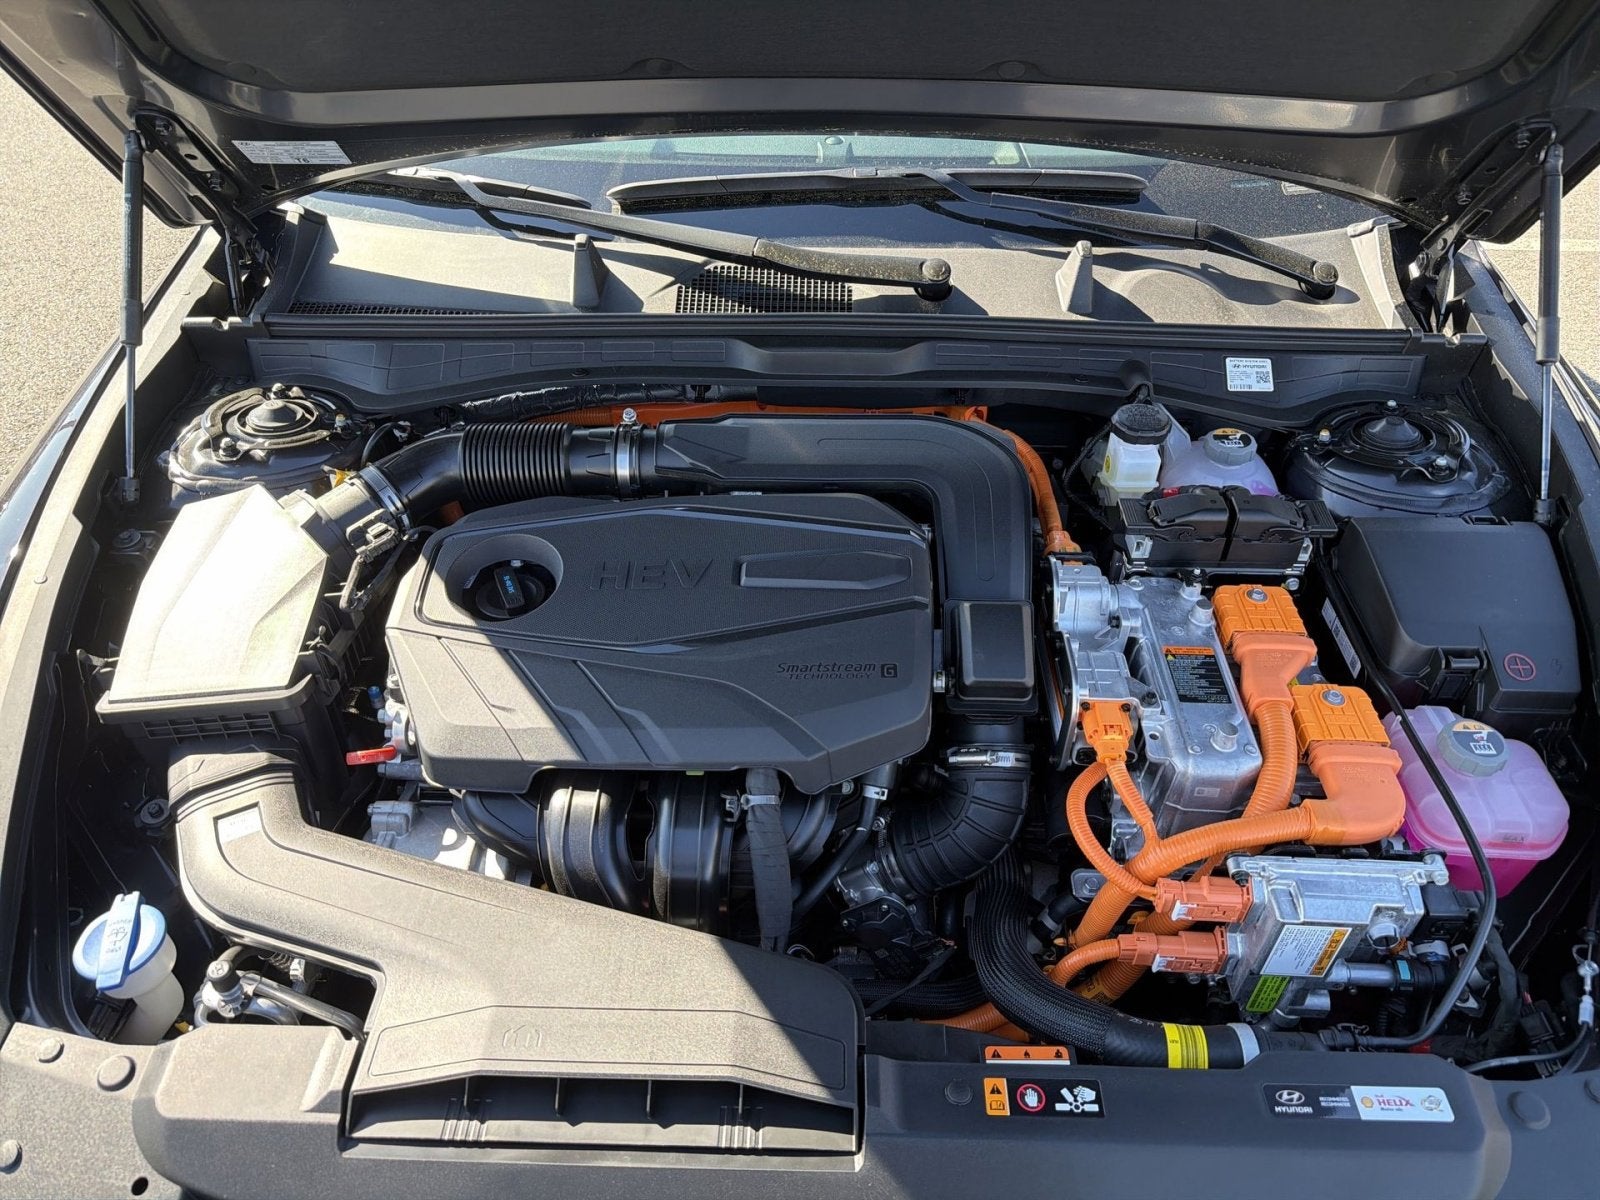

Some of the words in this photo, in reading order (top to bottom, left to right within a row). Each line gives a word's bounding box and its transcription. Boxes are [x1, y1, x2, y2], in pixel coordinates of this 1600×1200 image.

[590, 558, 714, 590] HEV
[776, 662, 877, 674] Smartstream
[881, 663, 898, 679] G
[788, 672, 874, 681] TECHNOLOGY
[1376, 1099, 1416, 1108] HELIX
[1274, 1105, 1314, 1114] HYUNDAI
